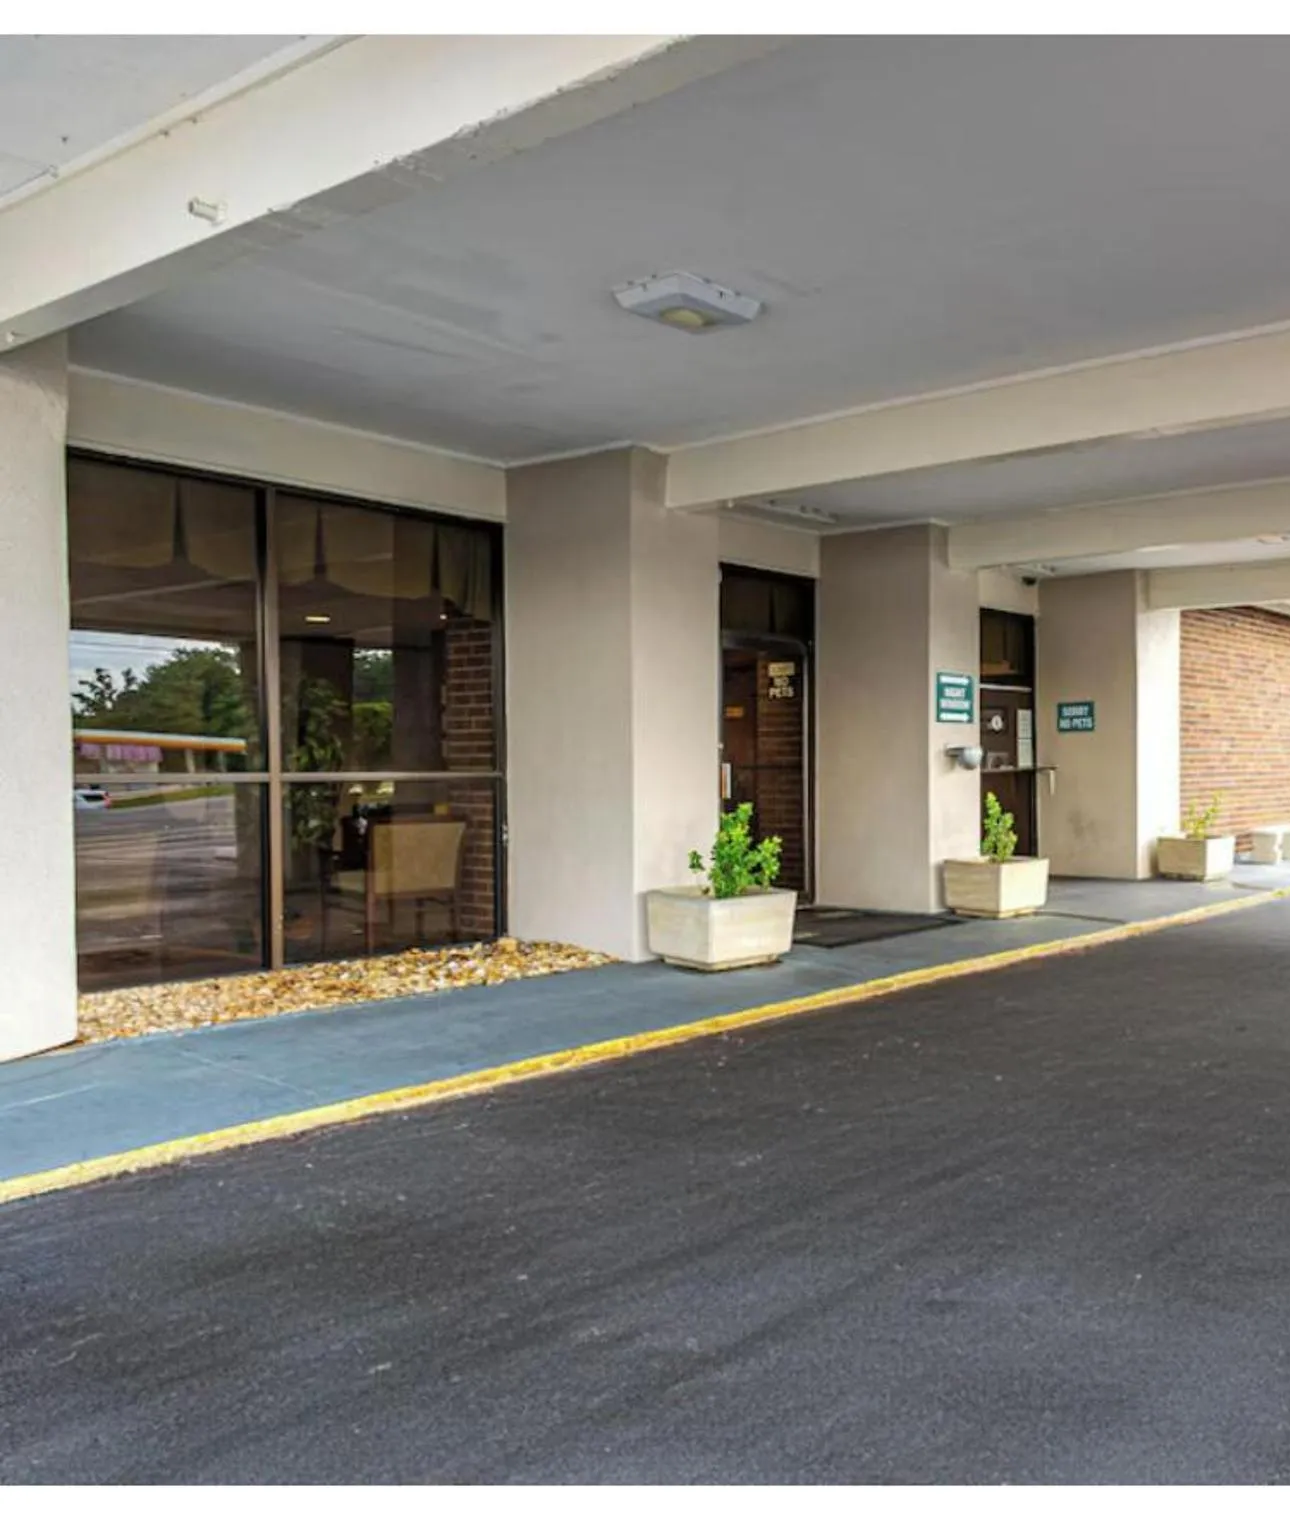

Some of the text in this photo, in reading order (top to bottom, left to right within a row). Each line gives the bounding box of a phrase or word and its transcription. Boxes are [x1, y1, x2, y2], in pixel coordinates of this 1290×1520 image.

[769, 687, 794, 698] PETS
[1061, 705, 1089, 716] SORRY
[1060, 717, 1092, 729] NO PETS
